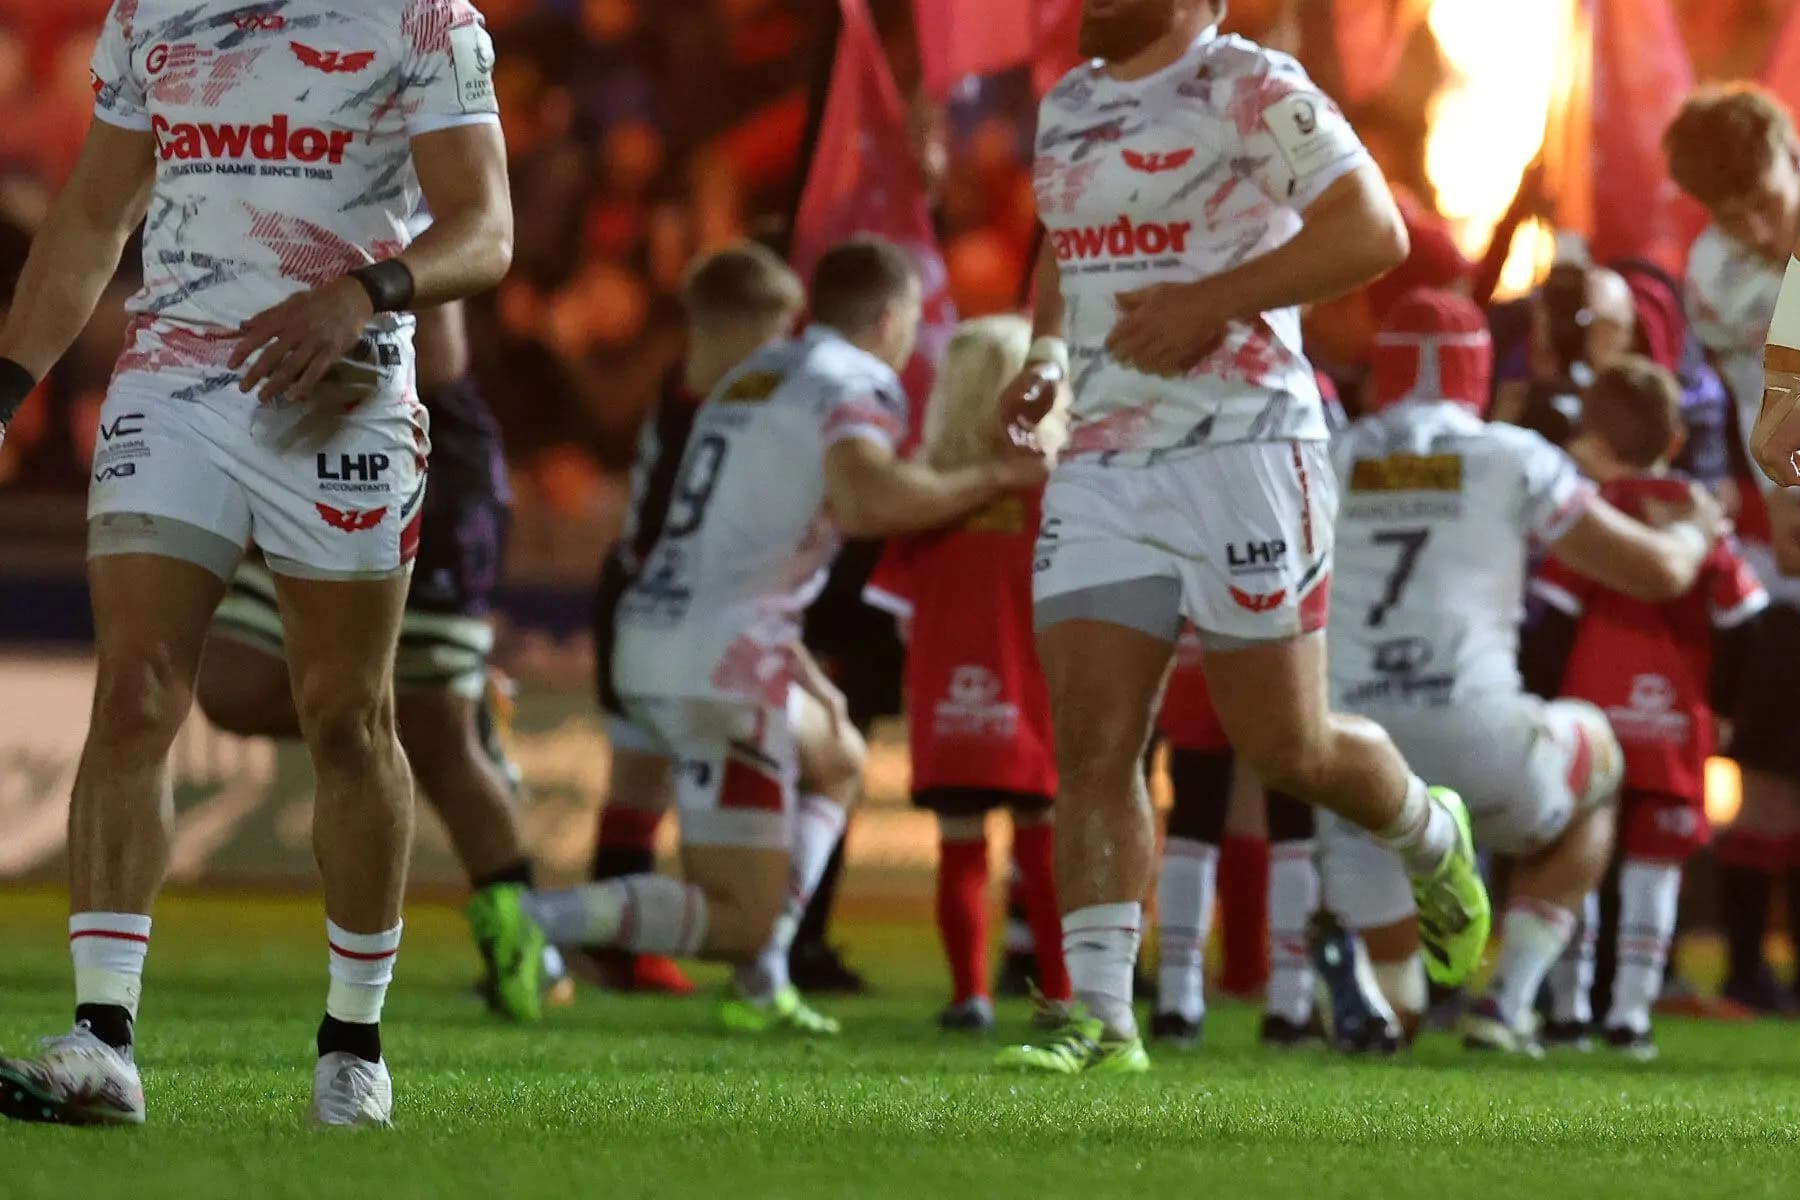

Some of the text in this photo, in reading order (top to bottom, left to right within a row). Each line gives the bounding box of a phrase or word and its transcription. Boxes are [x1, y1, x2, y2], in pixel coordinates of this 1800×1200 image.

[151, 113, 353, 165] Cawdor
[216, 164, 256, 177] NAME
[260, 165, 300, 178] SINCE
[1053, 214, 1191, 260] awdor
[317, 453, 390, 481] LHP
[667, 433, 727, 540] 9
[1226, 540, 1286, 564] LHP
[1369, 527, 1430, 628] 7
